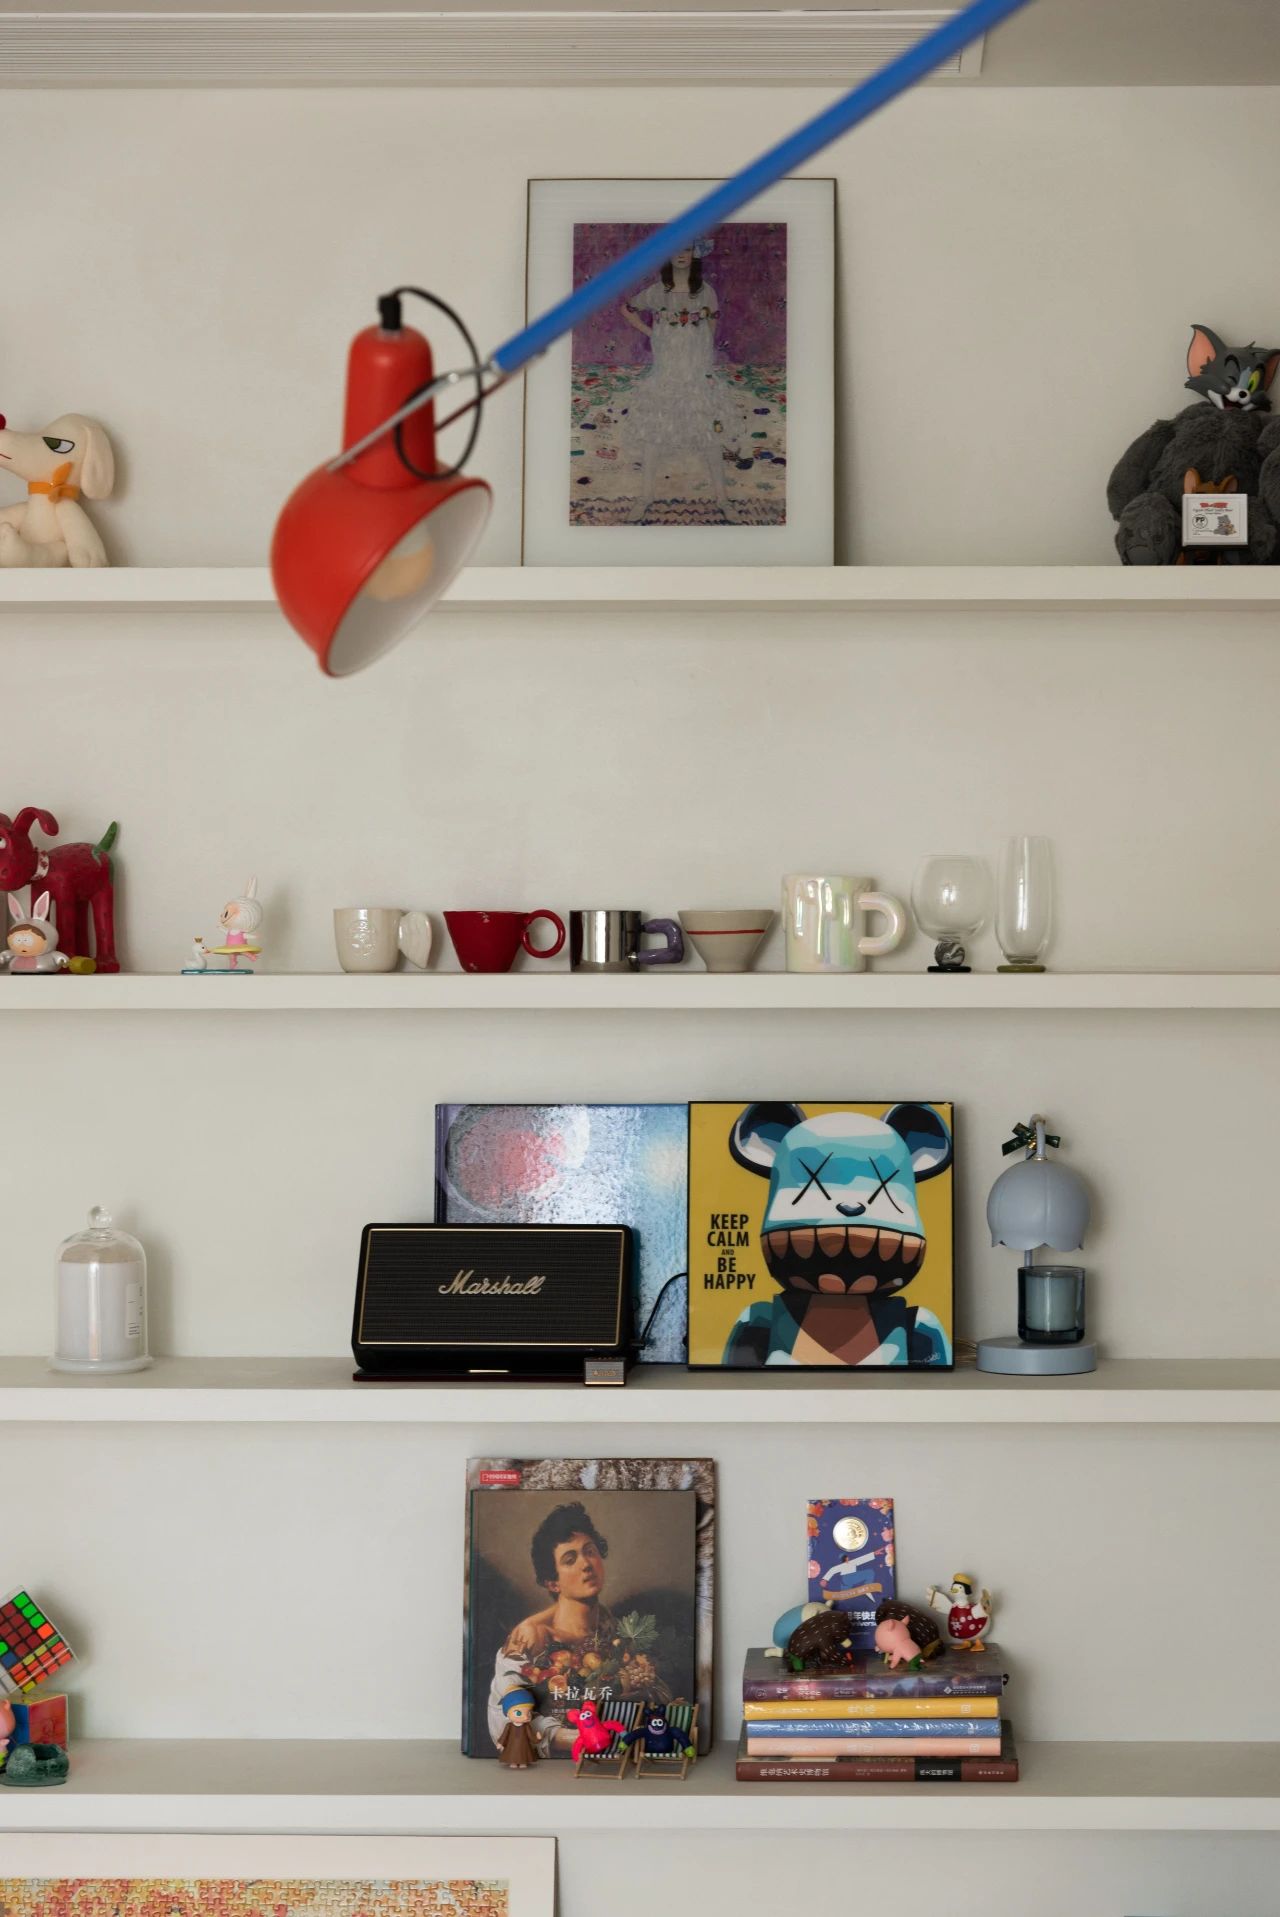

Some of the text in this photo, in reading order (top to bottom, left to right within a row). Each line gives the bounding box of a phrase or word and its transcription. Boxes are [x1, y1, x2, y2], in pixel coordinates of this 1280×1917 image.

[710, 1213, 749, 1229] KEEP
[707, 1231, 750, 1247] CALM
[721, 1248, 735, 1256] AND
[717, 1257, 737, 1272] BE
[438, 1269, 547, 1295] Marshall
[704, 1273, 756, 1289] HAPPY
[550, 1685, 613, 1701] 卡拉瓦乔
